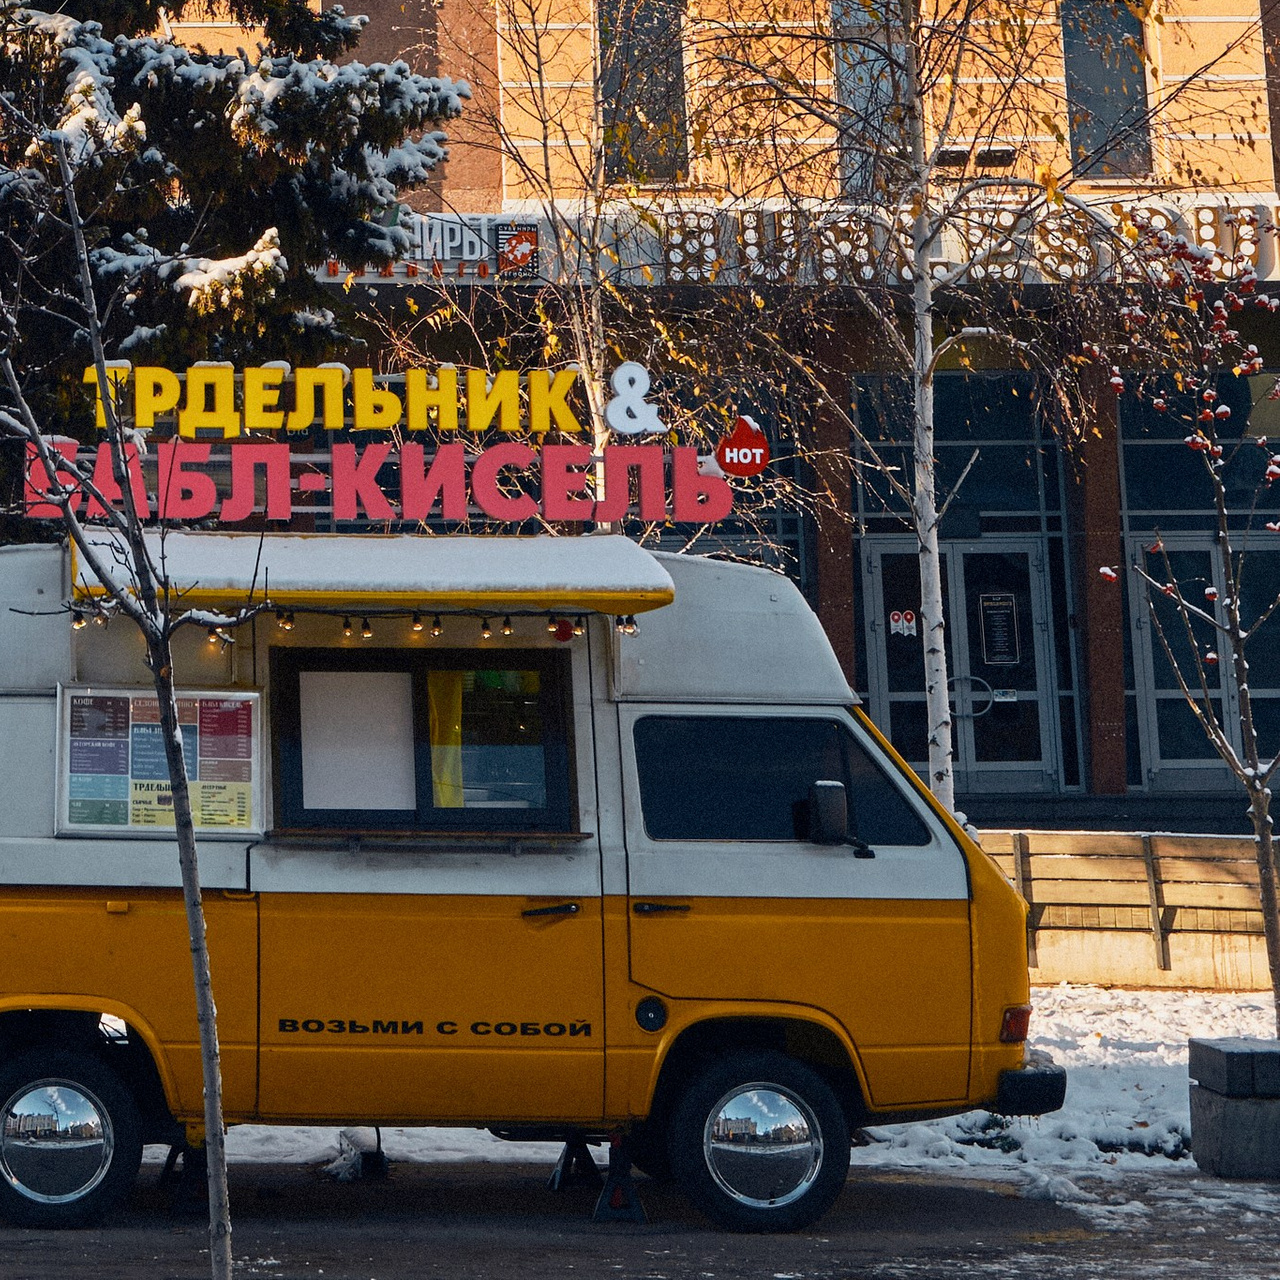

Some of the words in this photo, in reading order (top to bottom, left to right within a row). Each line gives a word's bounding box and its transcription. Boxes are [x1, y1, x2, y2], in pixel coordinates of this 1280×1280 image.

[82, 365, 583, 439] ТРДЕЛЬНИК
[606, 360, 668, 435] &
[724, 447, 765, 465] HOT
[24, 441, 733, 523] БАБЛ-КИСЕЛЬ
[278, 1018, 424, 1035] ВОЗЬМИ
[436, 1021, 458, 1035] С
[470, 1018, 592, 1037] СОБОЙ
